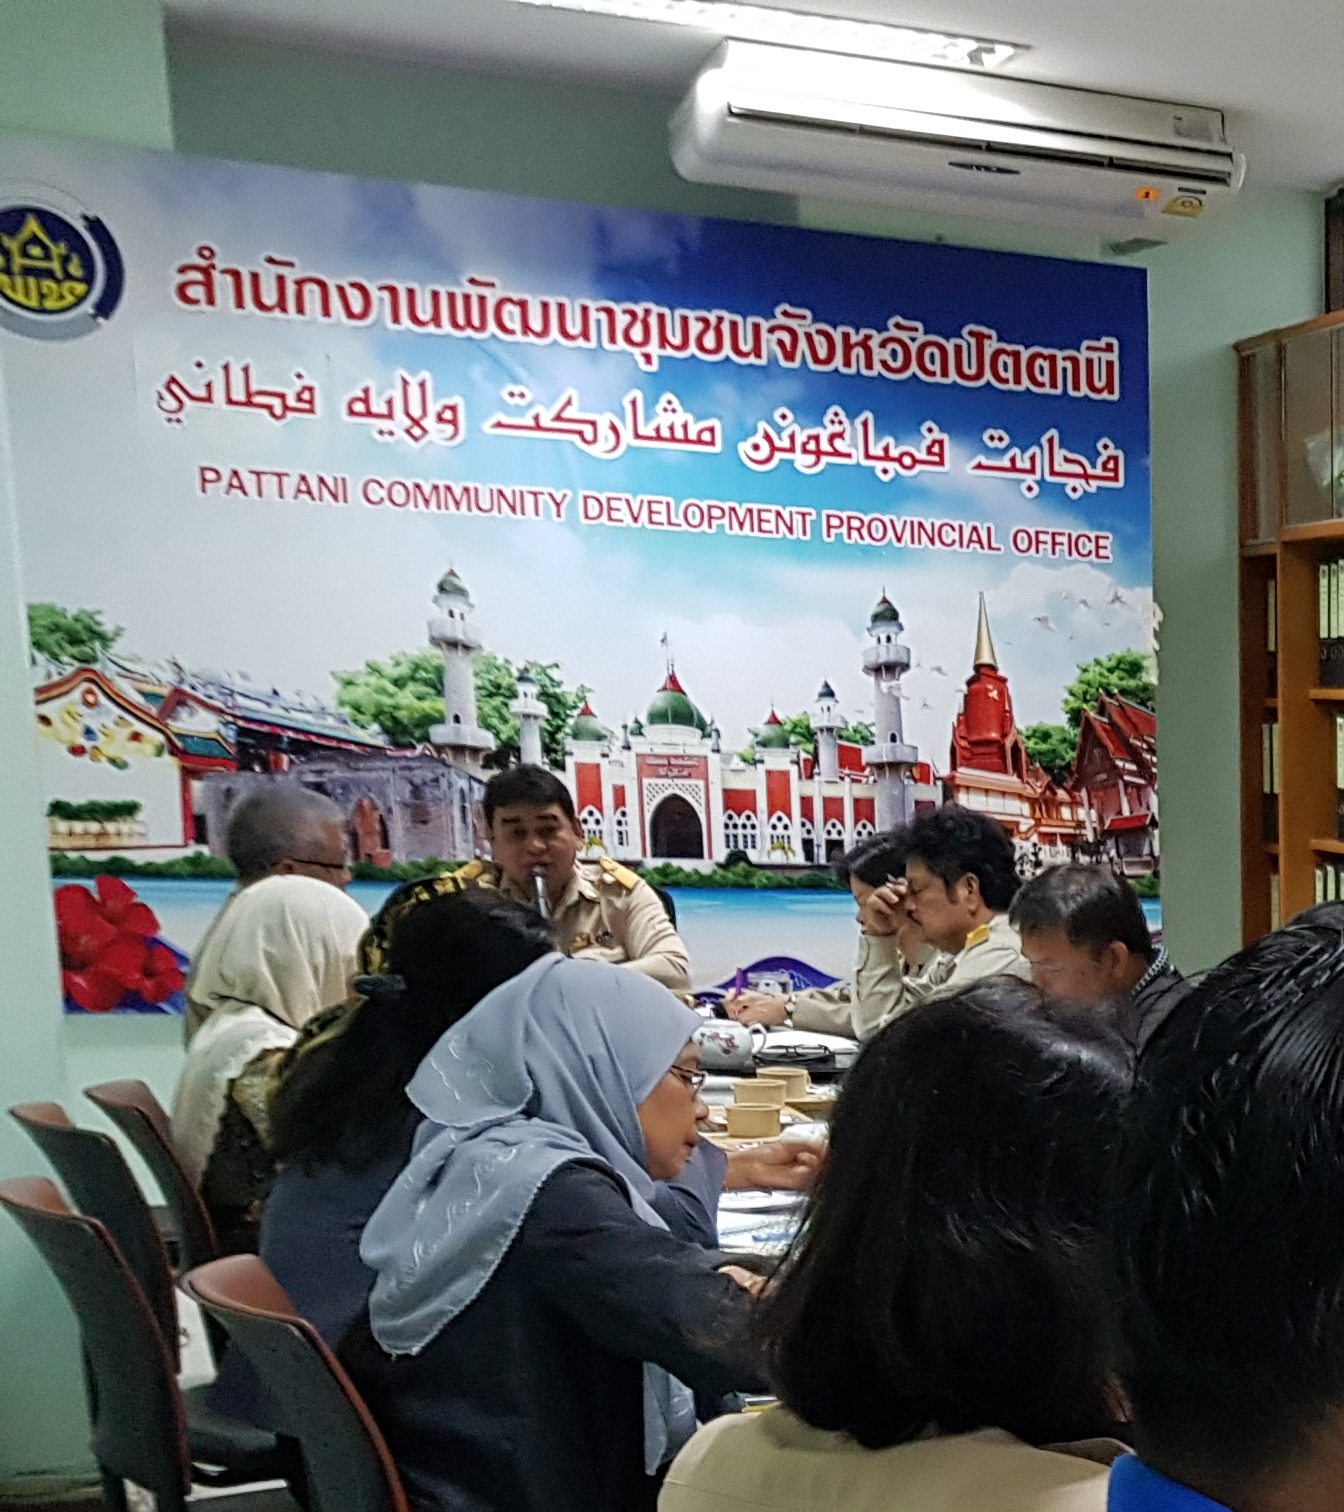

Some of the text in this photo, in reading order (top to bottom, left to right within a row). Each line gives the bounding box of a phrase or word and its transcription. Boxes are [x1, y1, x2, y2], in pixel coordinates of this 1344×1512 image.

[175, 245, 1116, 396] สำนักงานพัฒนาชุมชนจังหวัดปัตตานี
[199, 466, 1110, 560] PATTANI COMMUNITY DEVELOPMENT PROVINCIAL OFFICE
